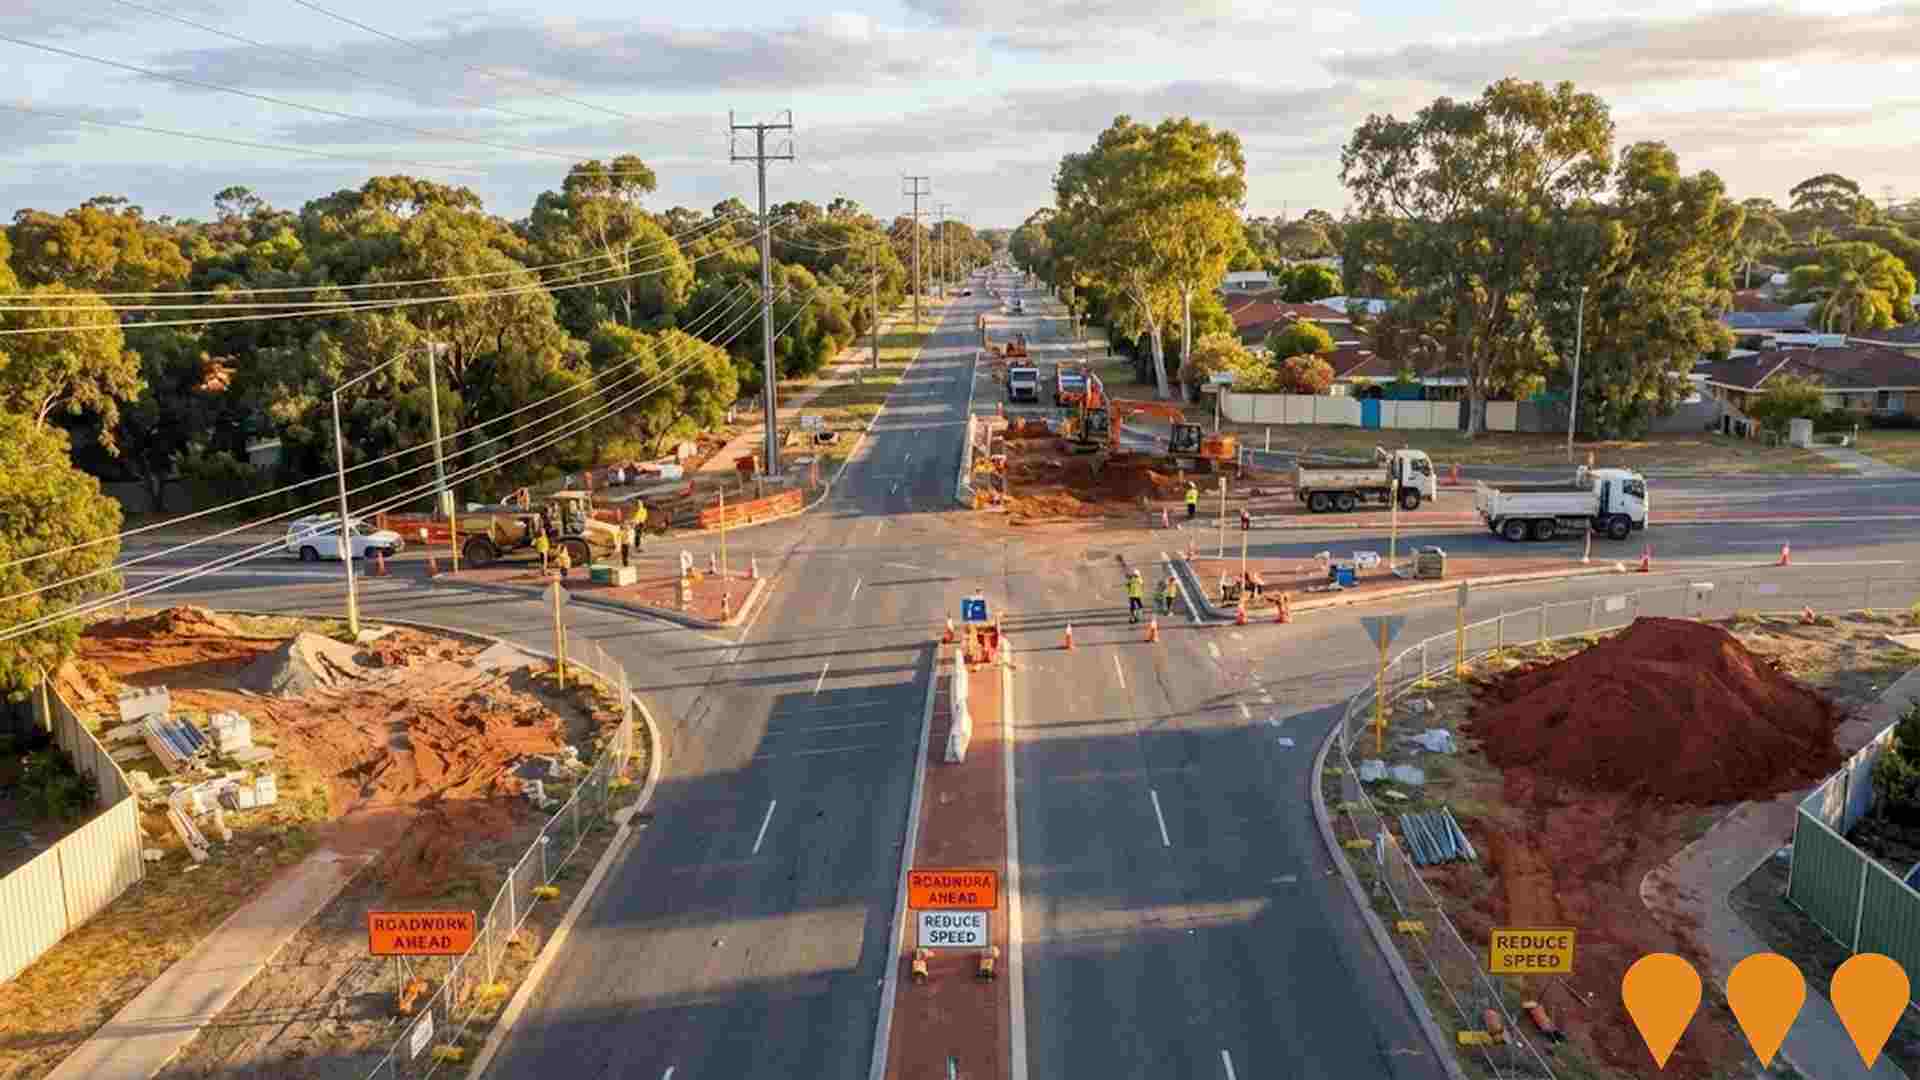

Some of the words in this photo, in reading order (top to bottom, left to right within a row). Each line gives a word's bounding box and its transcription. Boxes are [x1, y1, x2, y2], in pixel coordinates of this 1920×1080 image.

[928, 892, 977, 904] AHEAD
[925, 914, 981, 928] REDUCE
[393, 935, 452, 949] AHEAD
[929, 930, 976, 943] SPEED
[1496, 935, 1569, 949] REDUCE
[1503, 954, 1561, 968] SPEED
